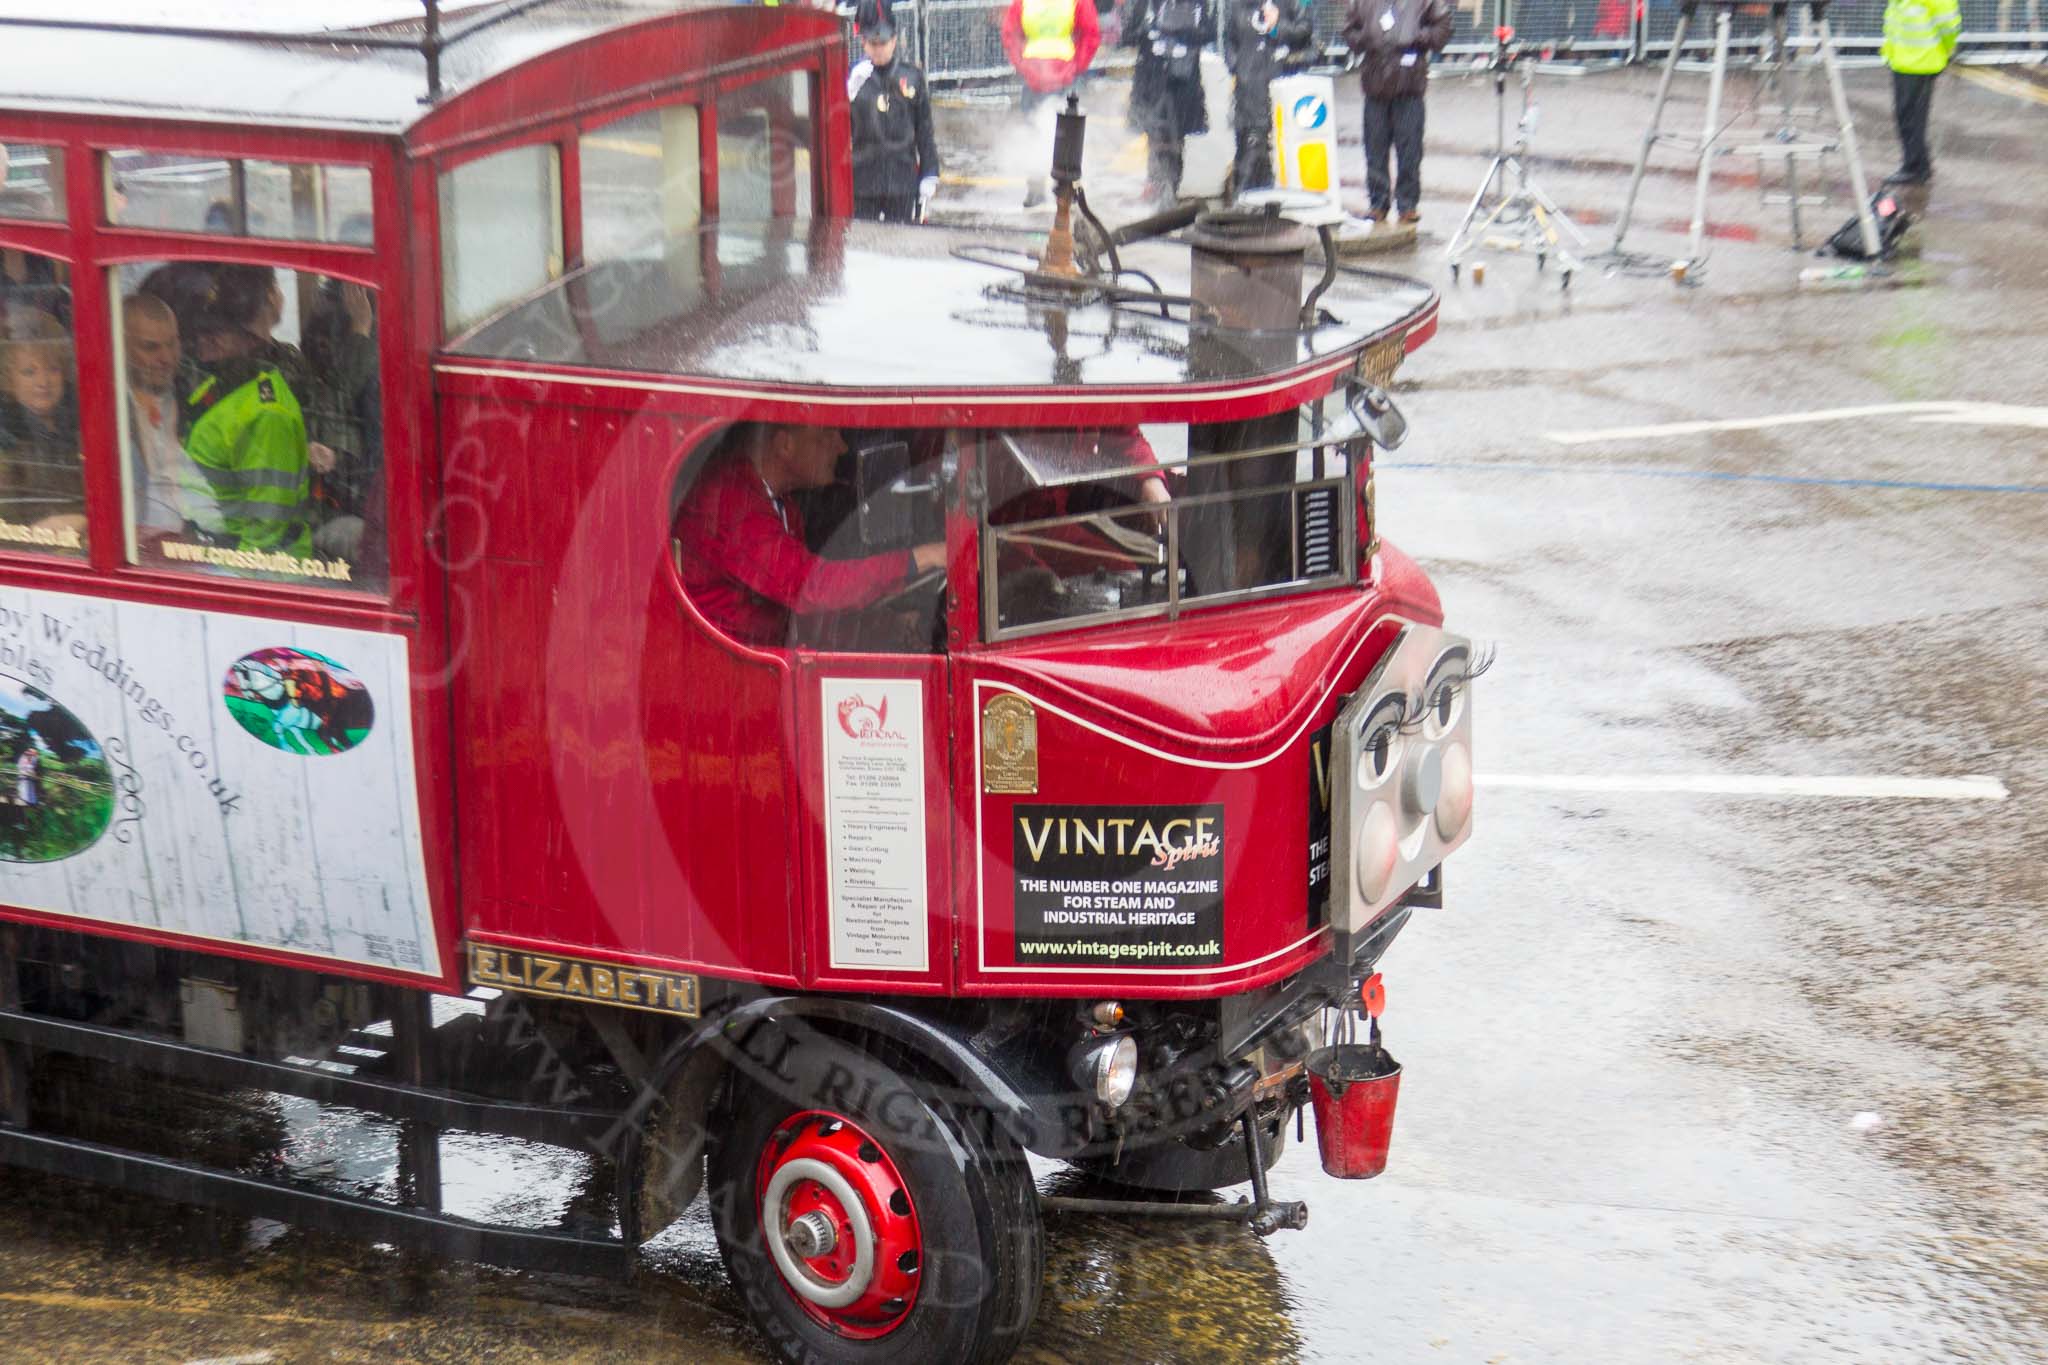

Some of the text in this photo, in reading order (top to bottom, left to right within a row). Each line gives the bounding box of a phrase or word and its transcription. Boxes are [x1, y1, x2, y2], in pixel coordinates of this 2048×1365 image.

[1019, 817, 1215, 862] VINTAGE
[1151, 832, 1220, 871] Spirit
[1020, 880, 1218, 894] THE NUMBER ONE MAGAZINE
[1064, 896, 1175, 909] FOR STEAM AND
[1043, 911, 1196, 925] INDUSTRIAL HERITAGE
[1020, 940, 1220, 959] www.vintagespirit.co.uk
[475, 949, 691, 1011] ELIZABETH
